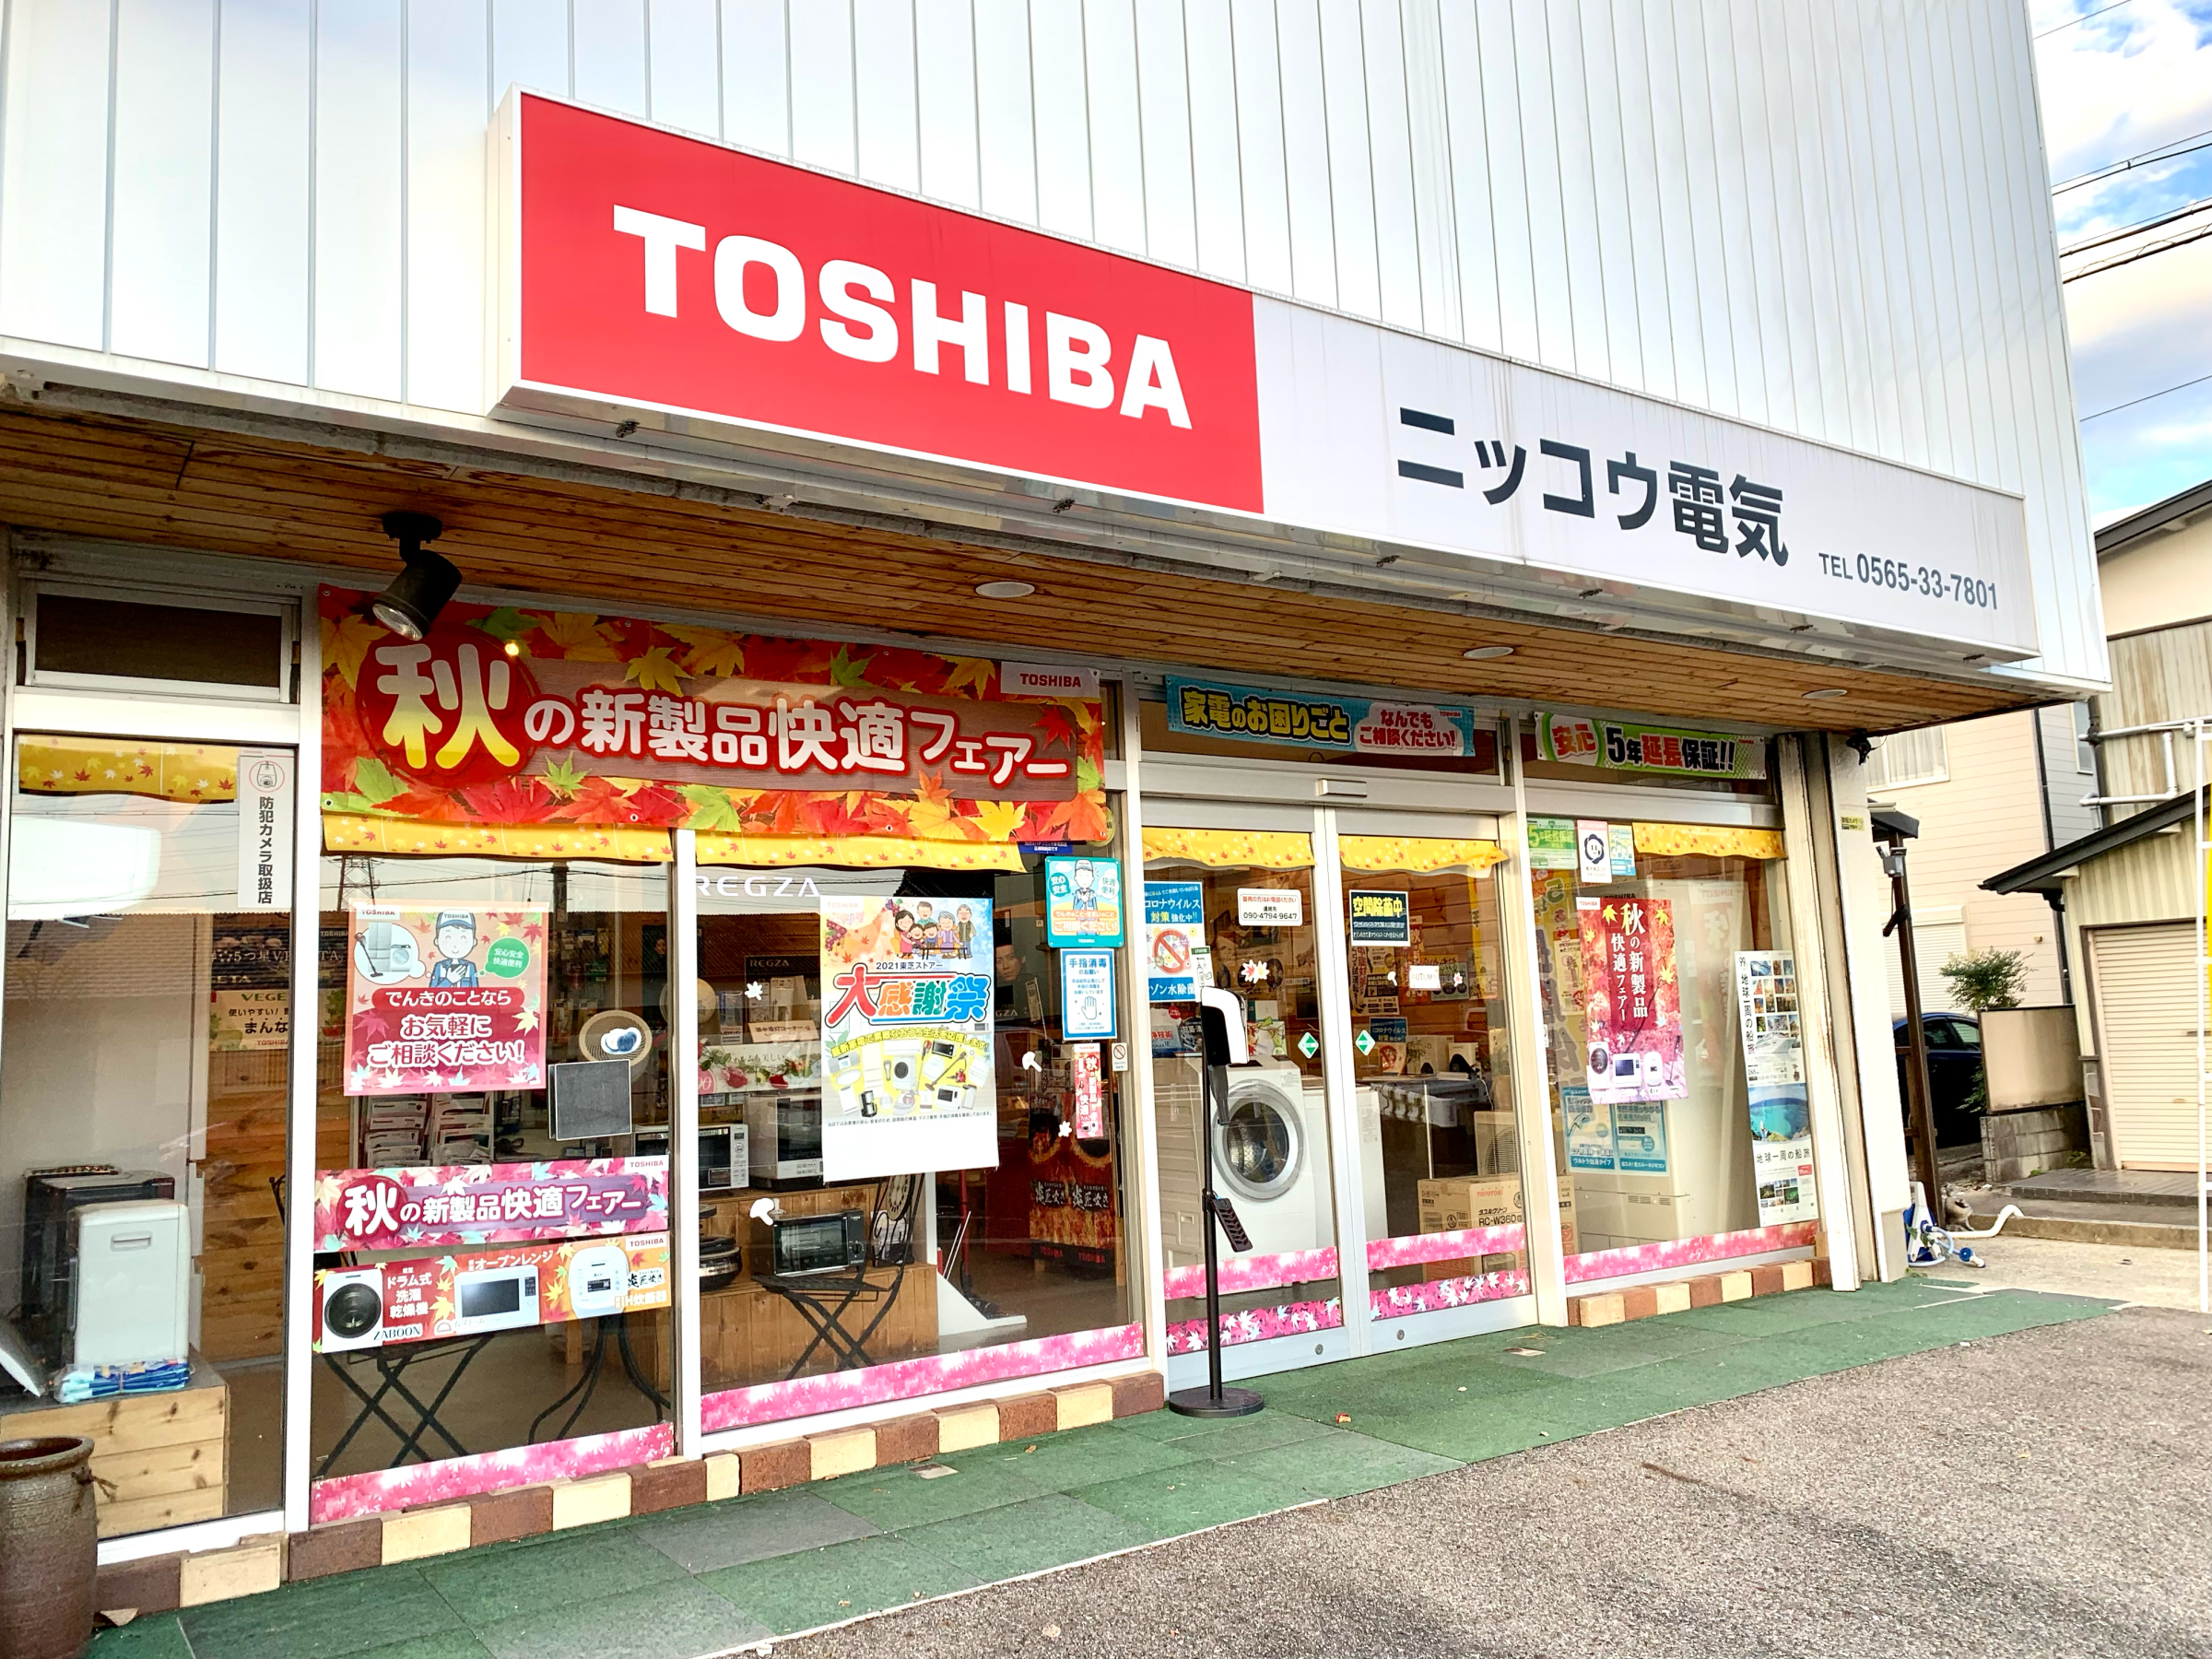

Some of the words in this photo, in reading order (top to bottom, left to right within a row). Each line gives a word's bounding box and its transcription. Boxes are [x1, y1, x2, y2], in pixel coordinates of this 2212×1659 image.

[614, 204, 1194, 430] TOSHIBA
[1397, 406, 1790, 568] ニッコウ電気
[1818, 553, 1853, 582] TEL
[1857, 554, 1998, 611] 0565-33-7801
[1019, 673, 1082, 688] TOSHIBA
[374, 641, 1069, 784] 秋の新製品快適フェアー
[1183, 690, 1349, 740] 家電のお困りごと
[1380, 710, 1434, 730] なんでも
[1359, 725, 1456, 747] ご相談ください!
[1551, 724, 1597, 757] 安心
[1606, 726, 1736, 772] 5年延長保証!!
[257, 796, 275, 905] 防犯カメラ取扱店
[696, 876, 820, 898] REGZA
[1145, 898, 1201, 910] コロナウイルス
[1352, 895, 1403, 918] 空間除菌中
[1150, 911, 1170, 923] 対策
[494, 947, 524, 958] 安心安全
[1619, 902, 1649, 1018] 秋の新製品
[493, 957, 523, 969] 快適便利
[749, 959, 790, 968] REGZA
[876, 961, 943, 971] 2021東芝ストアー
[1068, 958, 1107, 968] 手指消毒
[1610, 933, 1628, 1022] 快適フェアー
[384, 990, 512, 1006] でんきのことなら
[827, 964, 989, 1026] 大感謝祭
[1149, 982, 1195, 995] ゾン水除菌
[1741, 973, 1756, 1054] 地球一周の船旅
[403, 1016, 491, 1038] お気軽に
[370, 1042, 524, 1065] ご相談ください!
[629, 1159, 665, 1168] TOSHIBA
[1756, 1147, 1811, 1164] 地球一周の船旅
[345, 1182, 642, 1236] 秋の新製品快適フェアー
[629, 1238, 665, 1247] TOSHIBA
[475, 1250, 554, 1270] オーブンレンジ
[387, 1272, 432, 1289] ドラム式
[395, 1288, 422, 1304] 洗濯
[389, 1301, 429, 1319] 乾燥機
[372, 1325, 421, 1341] ZABOON
